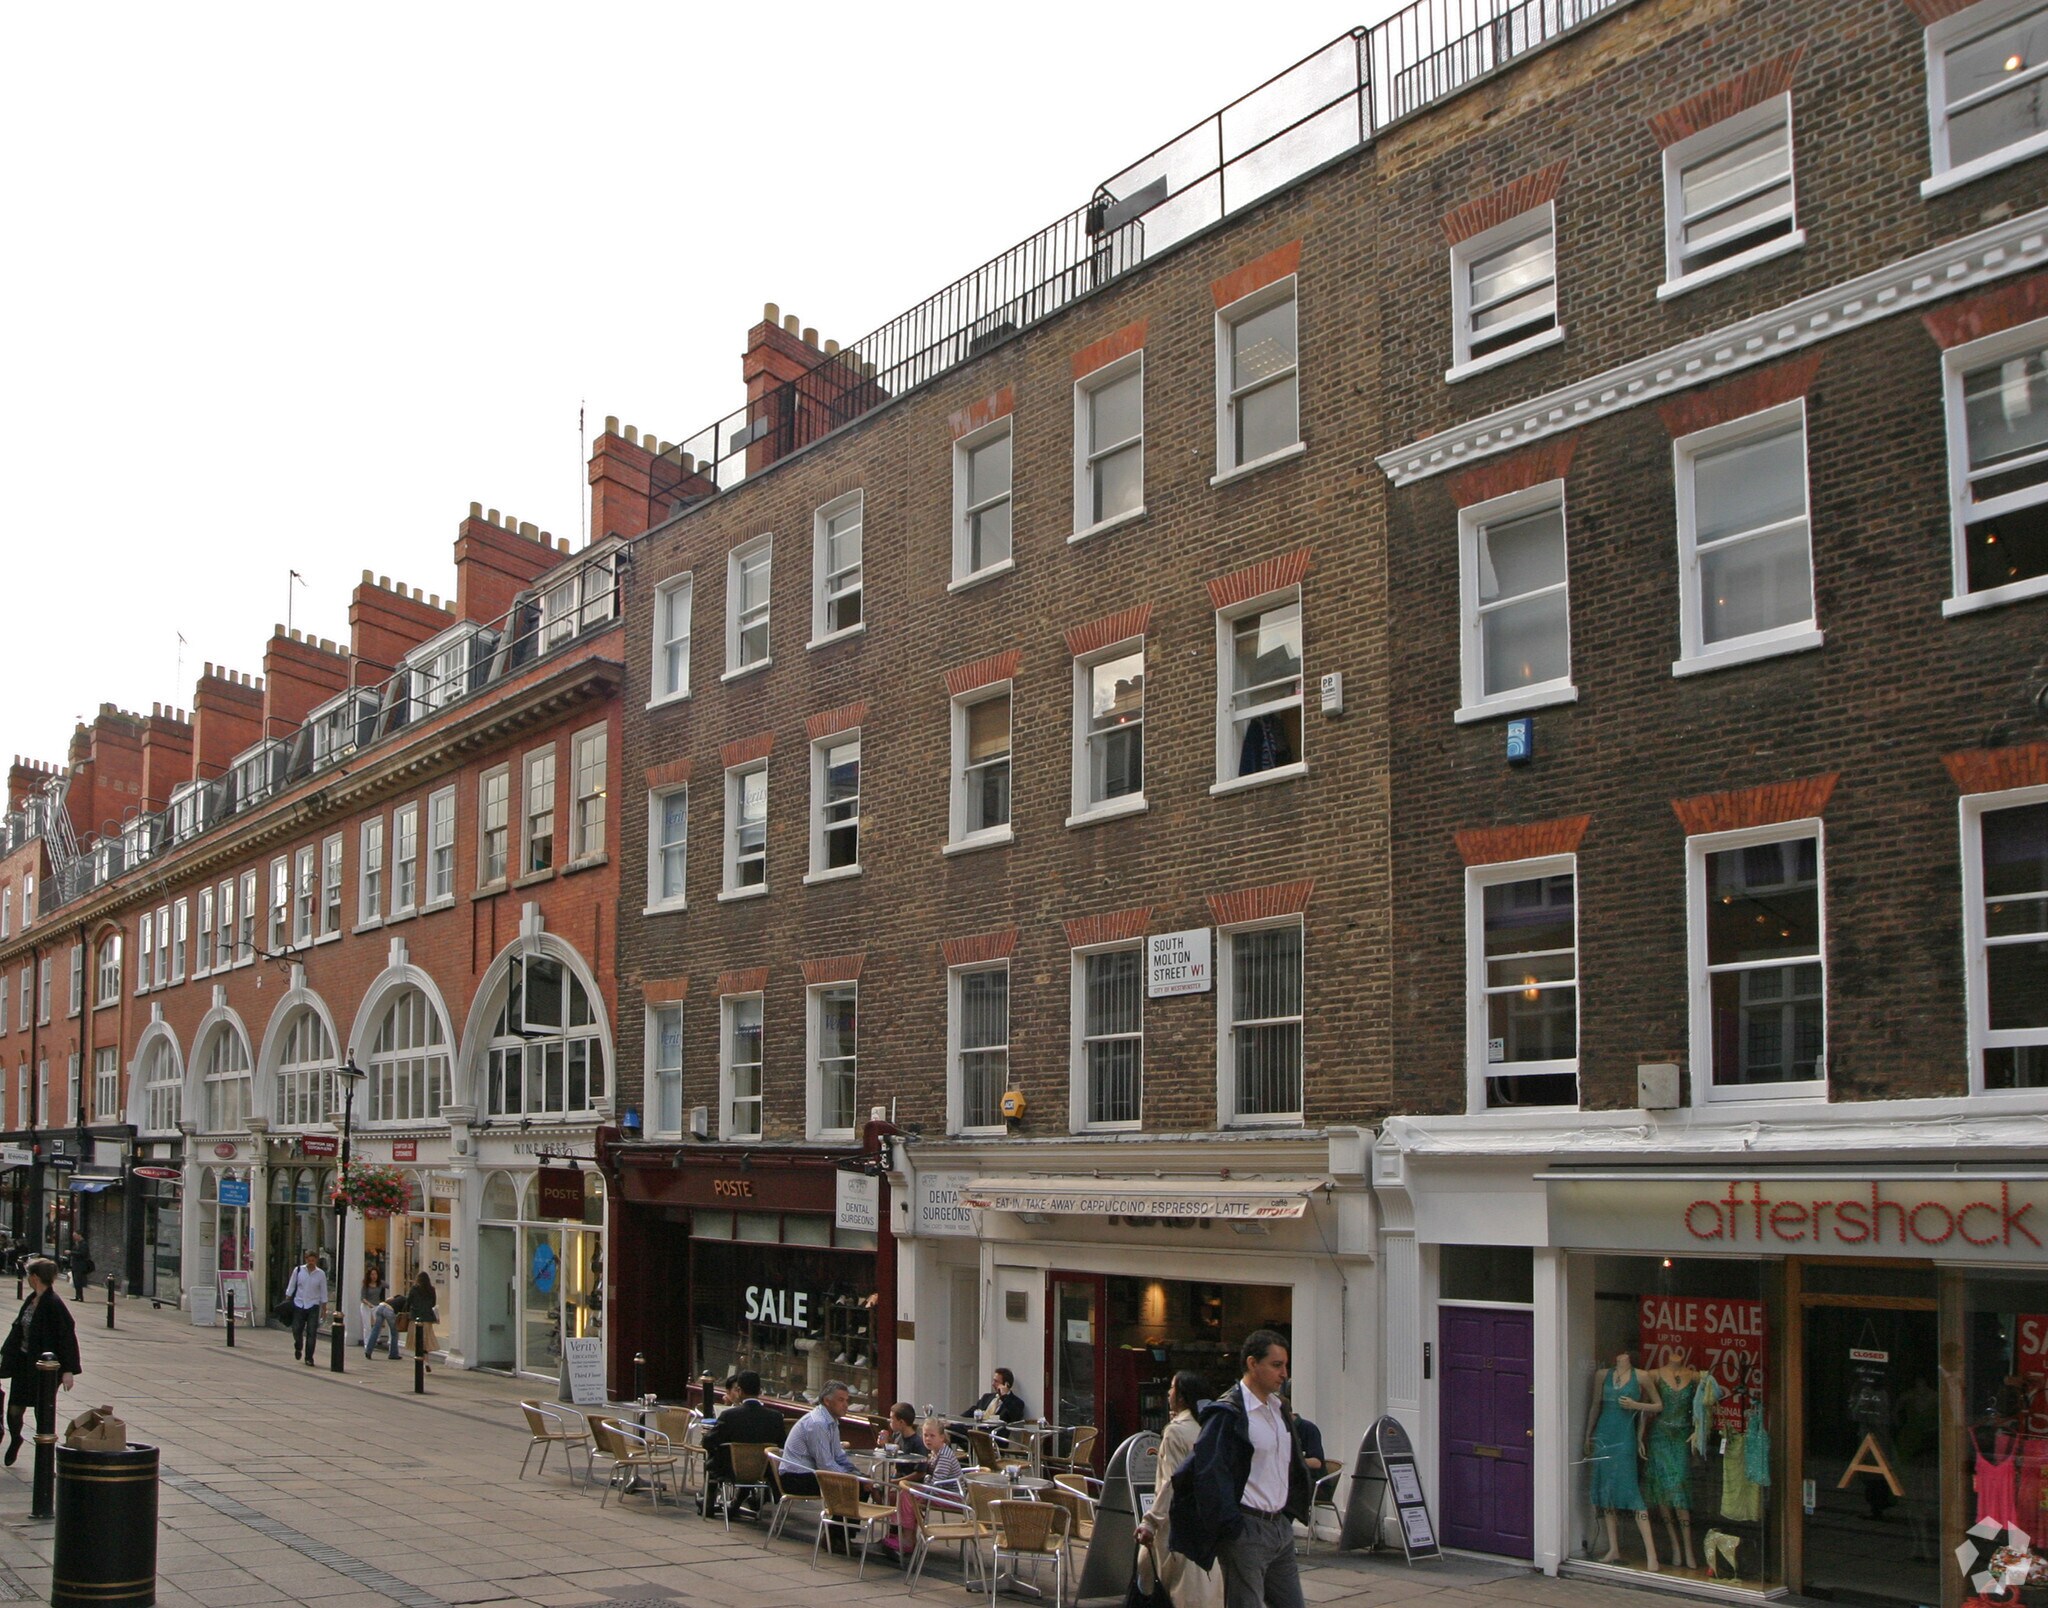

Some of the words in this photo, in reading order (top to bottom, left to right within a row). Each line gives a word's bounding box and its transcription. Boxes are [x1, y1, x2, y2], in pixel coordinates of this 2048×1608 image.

[1153, 937, 1184, 952] SOUTH
[1153, 950, 1191, 967] MOLTON
[1153, 965, 1187, 981] STREET
[1190, 963, 1204, 977] W1
[1153, 986, 1164, 994] CITY
[1165, 985, 1170, 993] OF
[1170, 982, 1201, 992] WESTMINSTER
[513, 1143, 539, 1154] NINE
[541, 1142, 568, 1155] WEST
[434, 1179, 456, 1187] NINE
[435, 1185, 456, 1193] WEST
[714, 1179, 752, 1197] POSTE
[544, 1187, 579, 1200] POSTE
[929, 1190, 958, 1203] DENTA
[845, 1202, 870, 1214] DENTAL
[922, 1206, 971, 1222] SURGEONS
[1080, 1200, 1146, 1213] CAPPUCCINO
[1151, 1201, 1208, 1215] ESPRESSO
[1215, 1202, 1250, 1215] LATTE
[1684, 1181, 2042, 1247] aftershock
[840, 1213, 875, 1226] SURGEONS
[454, 1263, 460, 1279] 9
[745, 1285, 808, 1328] SALE
[1642, 1299, 1698, 1332] SALE
[1704, 1303, 1763, 1336] SALE
[1657, 1333, 1670, 1342] UP
[1671, 1335, 1682, 1343] TO
[1720, 1338, 1732, 1347] UP
[1734, 1339, 1747, 1348] TO
[570, 1340, 598, 1354] Verity
[1853, 1351, 1885, 1360] CLOSED
[1704, 1350, 1764, 1385] 70%
[1836, 1432, 1905, 1497] A
